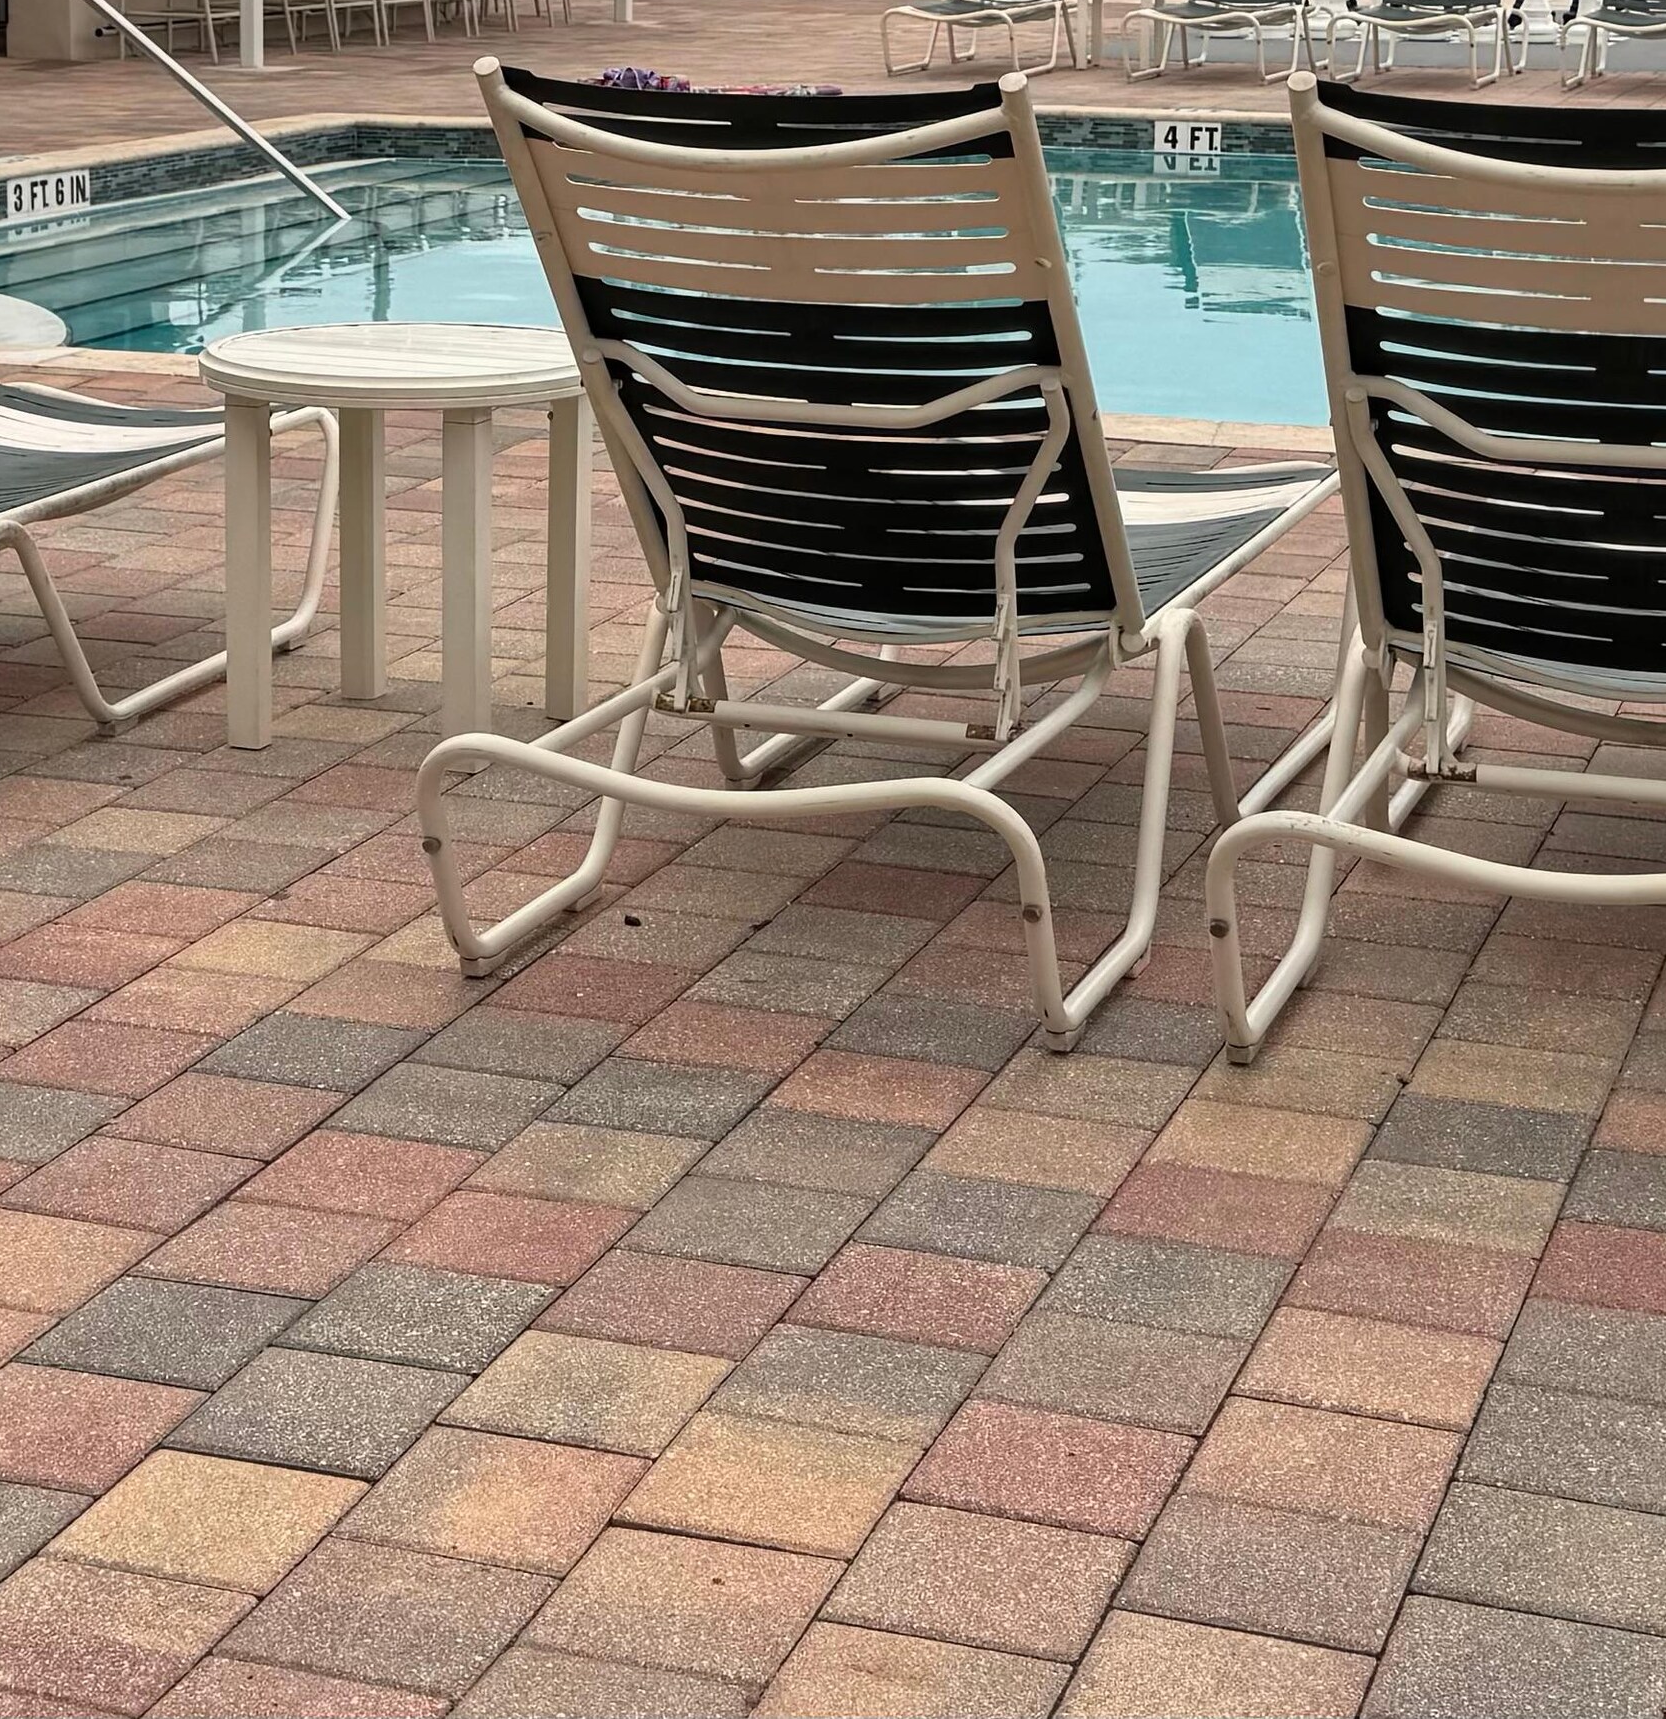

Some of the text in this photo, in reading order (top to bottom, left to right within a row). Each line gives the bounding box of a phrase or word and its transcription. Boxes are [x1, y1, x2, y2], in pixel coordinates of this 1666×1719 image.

[1164, 126, 1219, 151] 4 FT.
[14, 184, 23, 212] 3
[55, 178, 64, 205] 6
